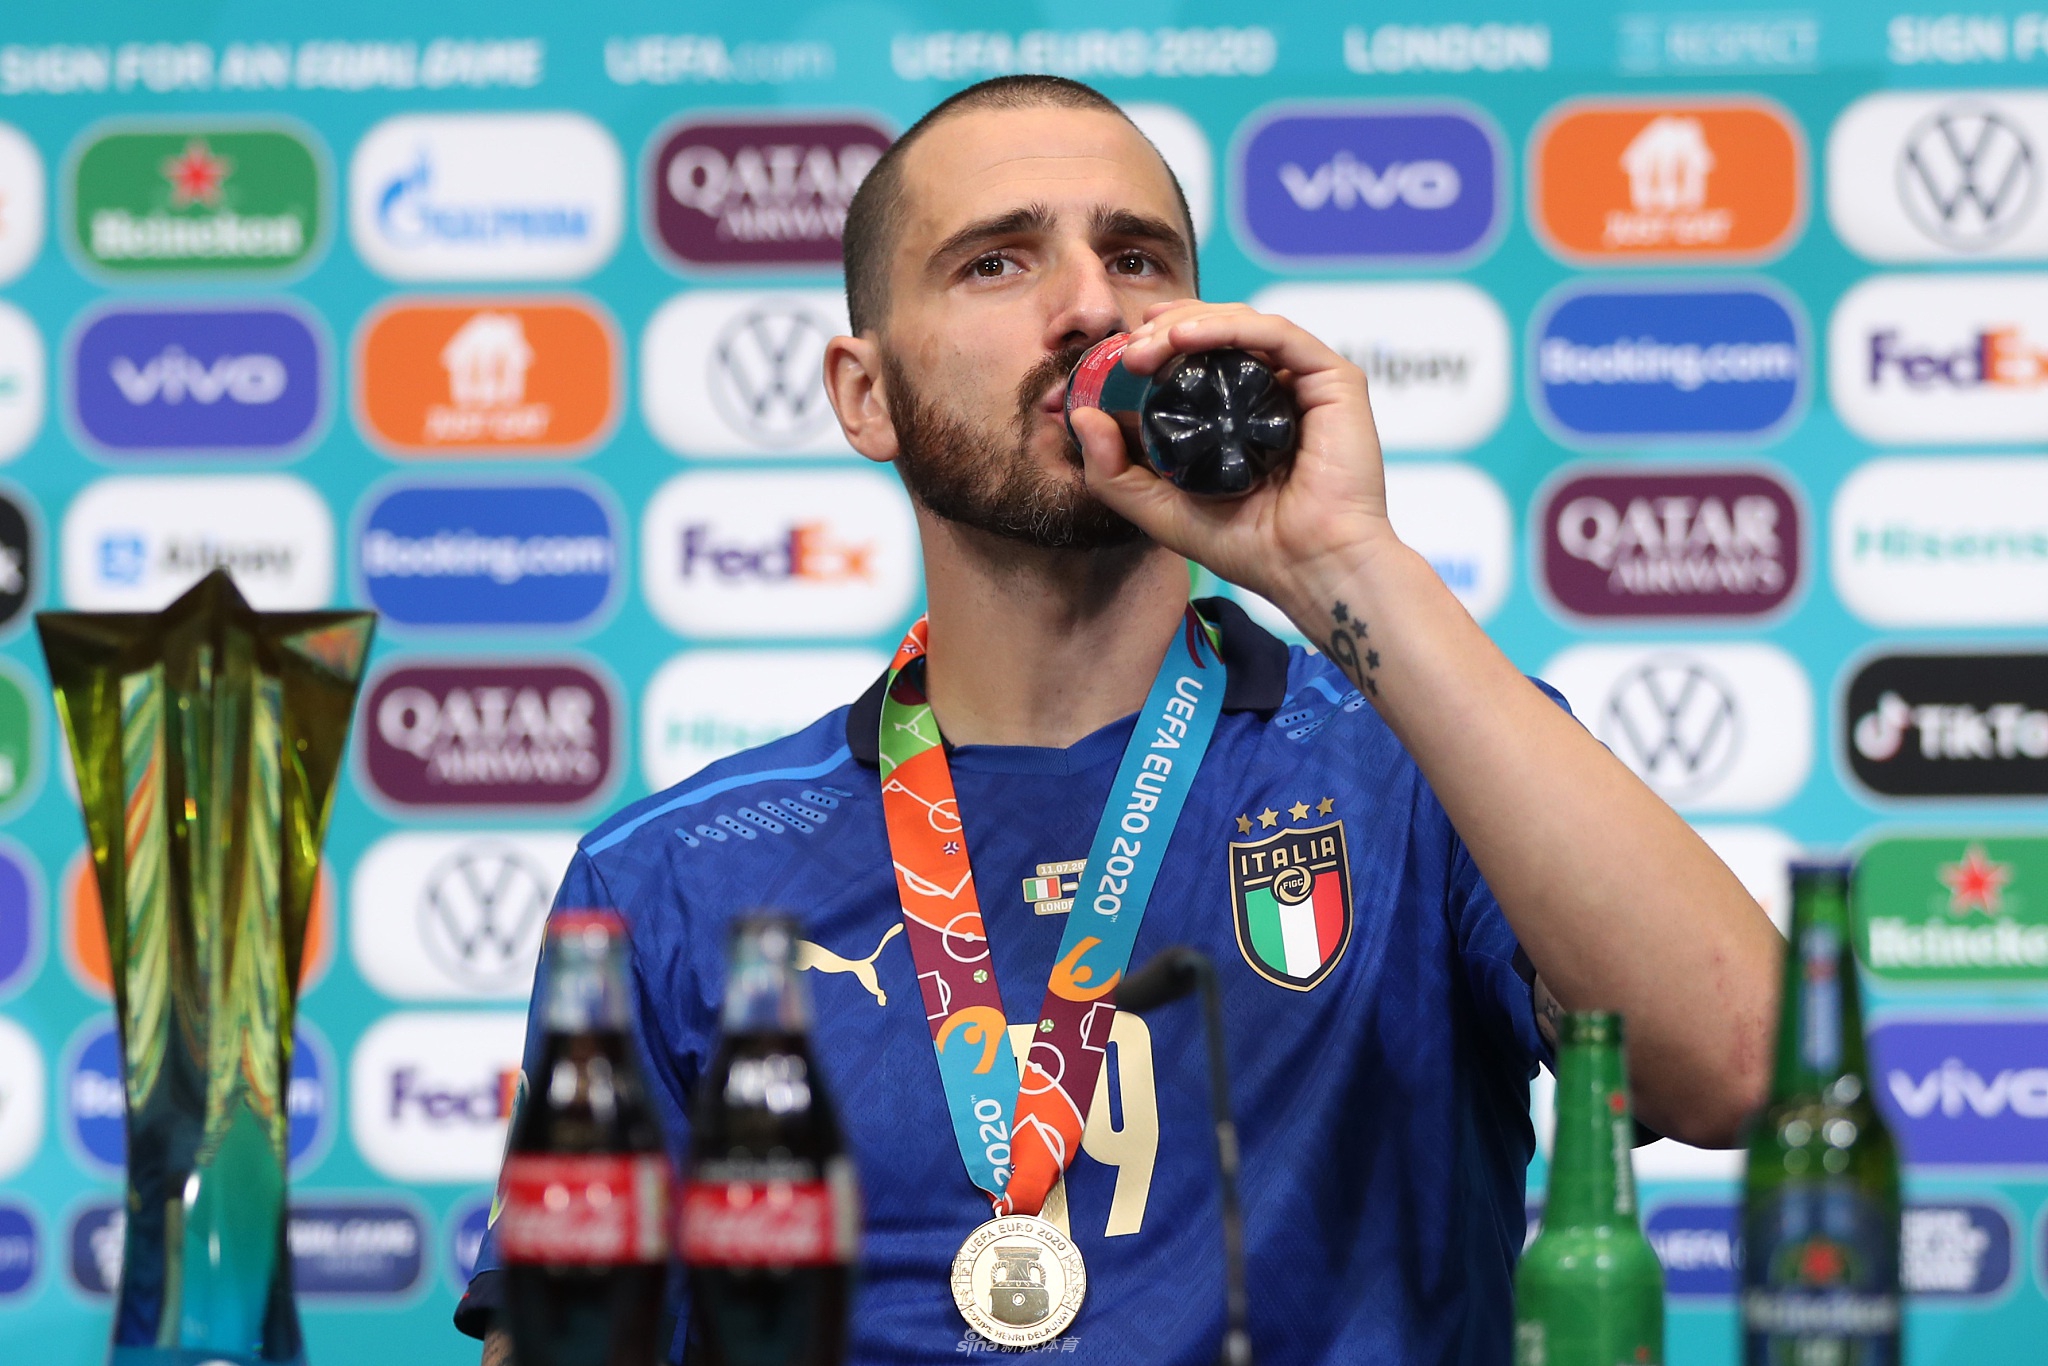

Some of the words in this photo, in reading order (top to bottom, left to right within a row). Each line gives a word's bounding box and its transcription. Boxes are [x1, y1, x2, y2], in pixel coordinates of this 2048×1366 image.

[115, 41, 214, 92] FOR
[220, 41, 294, 89] AN
[891, 32, 1013, 80] UEFA
[1342, 23, 1552, 74] LONDON
[1278, 150, 1462, 211] vivo
[93, 208, 302, 259] Heineken
[109, 344, 288, 406] vivo
[1539, 336, 1797, 391] Booking.com
[362, 529, 613, 584] Booking.com
[681, 522, 878, 584] FedEx
[1557, 495, 1782, 569] QATAR
[1608, 556, 1785, 595] AIRWAYS
[376, 685, 595, 761] QATAR
[1151, 676, 1202, 748] UEFA
[425, 748, 600, 786] AIRWAYS
[1120, 754, 1172, 833] EURO
[1041, 862, 1086, 875] 11.07.20
[1093, 837, 1141, 915] 2020
[1241, 836, 1336, 876] ITALIA
[1282, 878, 1304, 890] FIGC
[967, 1230, 996, 1254] UEFA
[998, 1222, 1034, 1234] EURO
[1037, 1228, 1067, 1251] 2020
[995, 1331, 1025, 1342] HENRI
[1027, 1309, 1071, 1341] DELAUNAY
